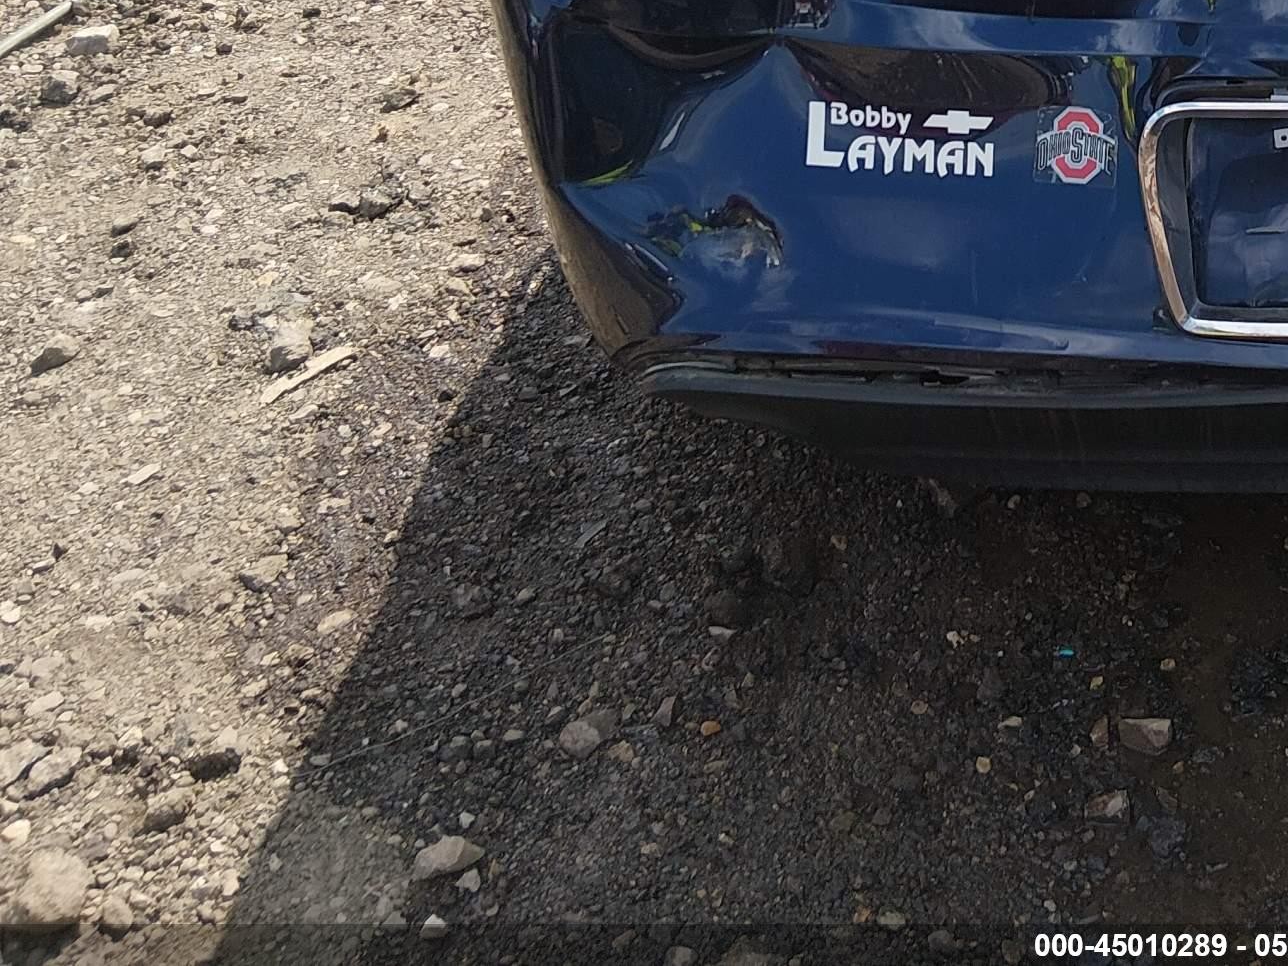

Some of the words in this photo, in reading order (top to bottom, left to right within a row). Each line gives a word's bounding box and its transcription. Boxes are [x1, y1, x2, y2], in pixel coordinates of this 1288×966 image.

[805, 100, 995, 179] LAYMAN
[830, 101, 912, 135] Bobby
[1036, 130, 1071, 171] OHIO
[1070, 127, 1115, 176] STATE
